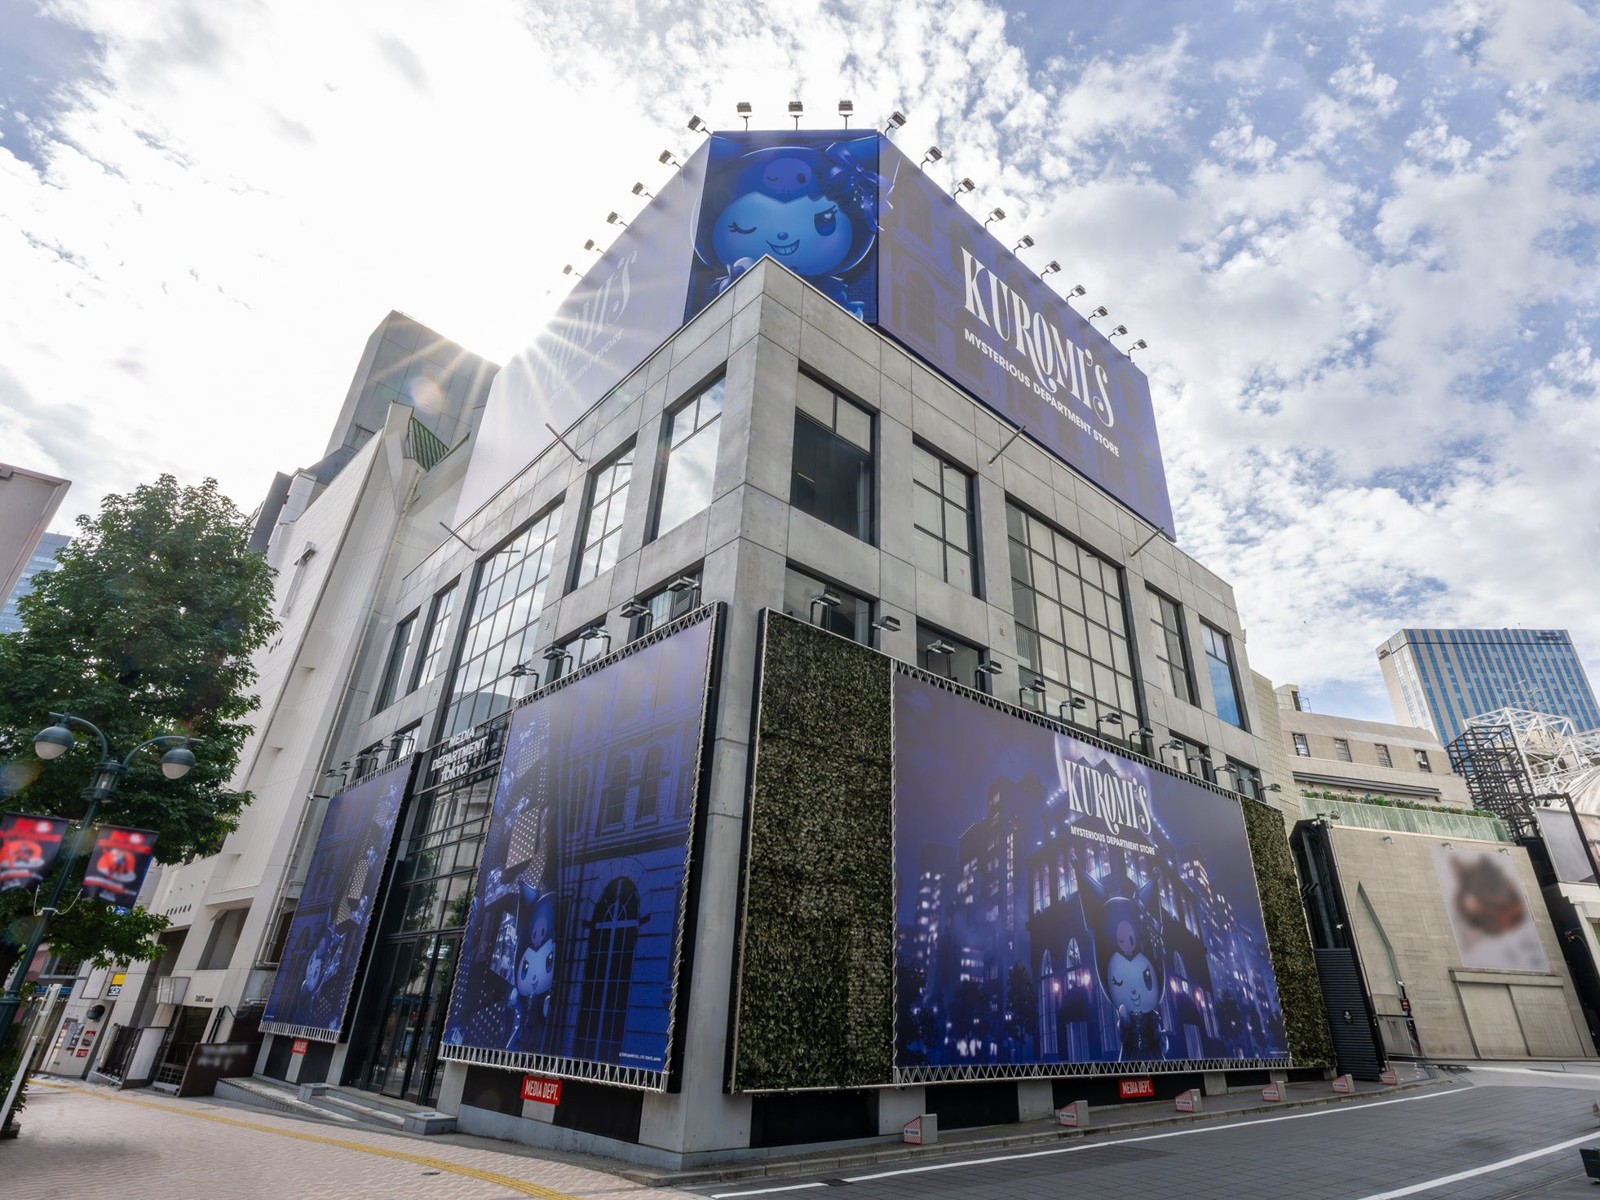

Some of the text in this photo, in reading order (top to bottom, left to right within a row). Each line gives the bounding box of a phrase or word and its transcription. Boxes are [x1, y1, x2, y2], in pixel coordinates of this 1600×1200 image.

[960, 246, 1115, 428] KUROMI'S
[964, 328, 1120, 458] MYSTERIOUS DEPARTMENT STORE
[448, 727, 476, 748] MEDIA
[431, 736, 489, 772] DEPARTMENT
[441, 762, 469, 783] TOKYO
[1065, 759, 1152, 835] KUROMI'S
[1070, 826, 1156, 856] MYSTERIOUS DEPARTMENT STORE
[524, 1079, 559, 1101] MEDIA DEPT.
[1121, 1081, 1138, 1095] MEDIA
